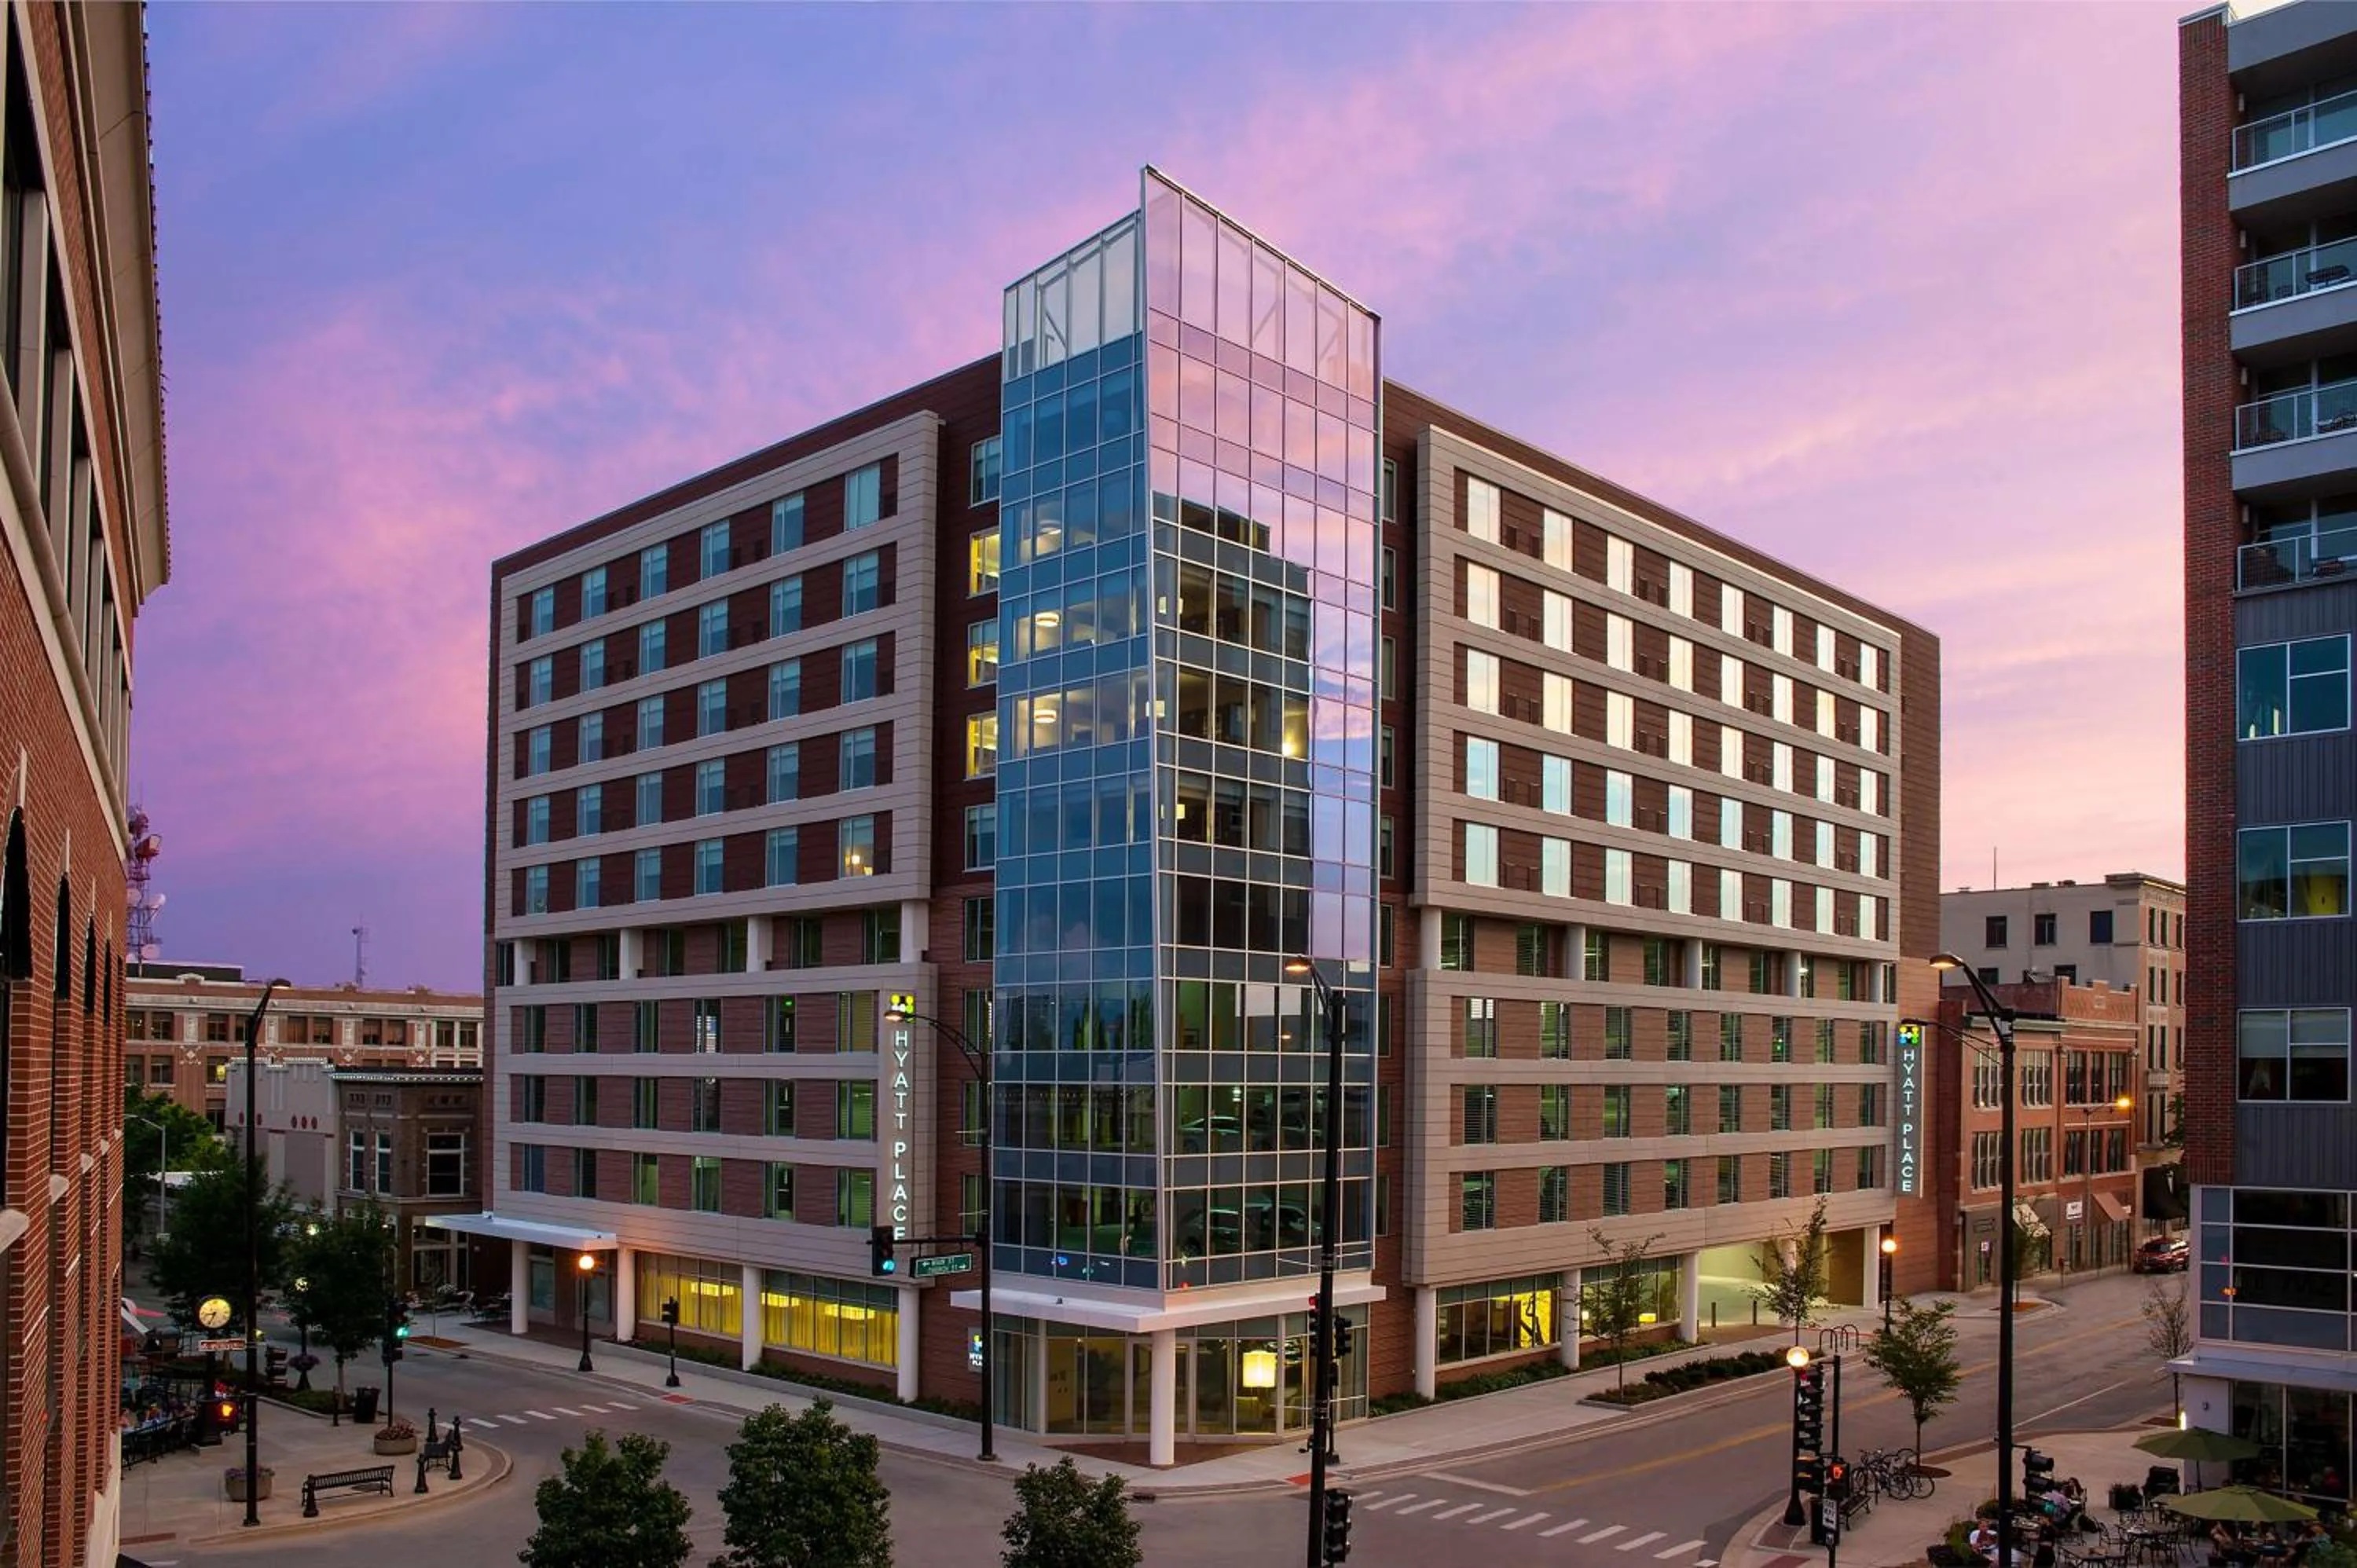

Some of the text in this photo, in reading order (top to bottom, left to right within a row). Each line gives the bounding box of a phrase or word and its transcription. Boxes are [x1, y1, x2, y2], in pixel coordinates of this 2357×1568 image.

[893, 1030, 908, 1241] HYATT PLACE
[1901, 1049, 1915, 1192] HYATT PLACE
